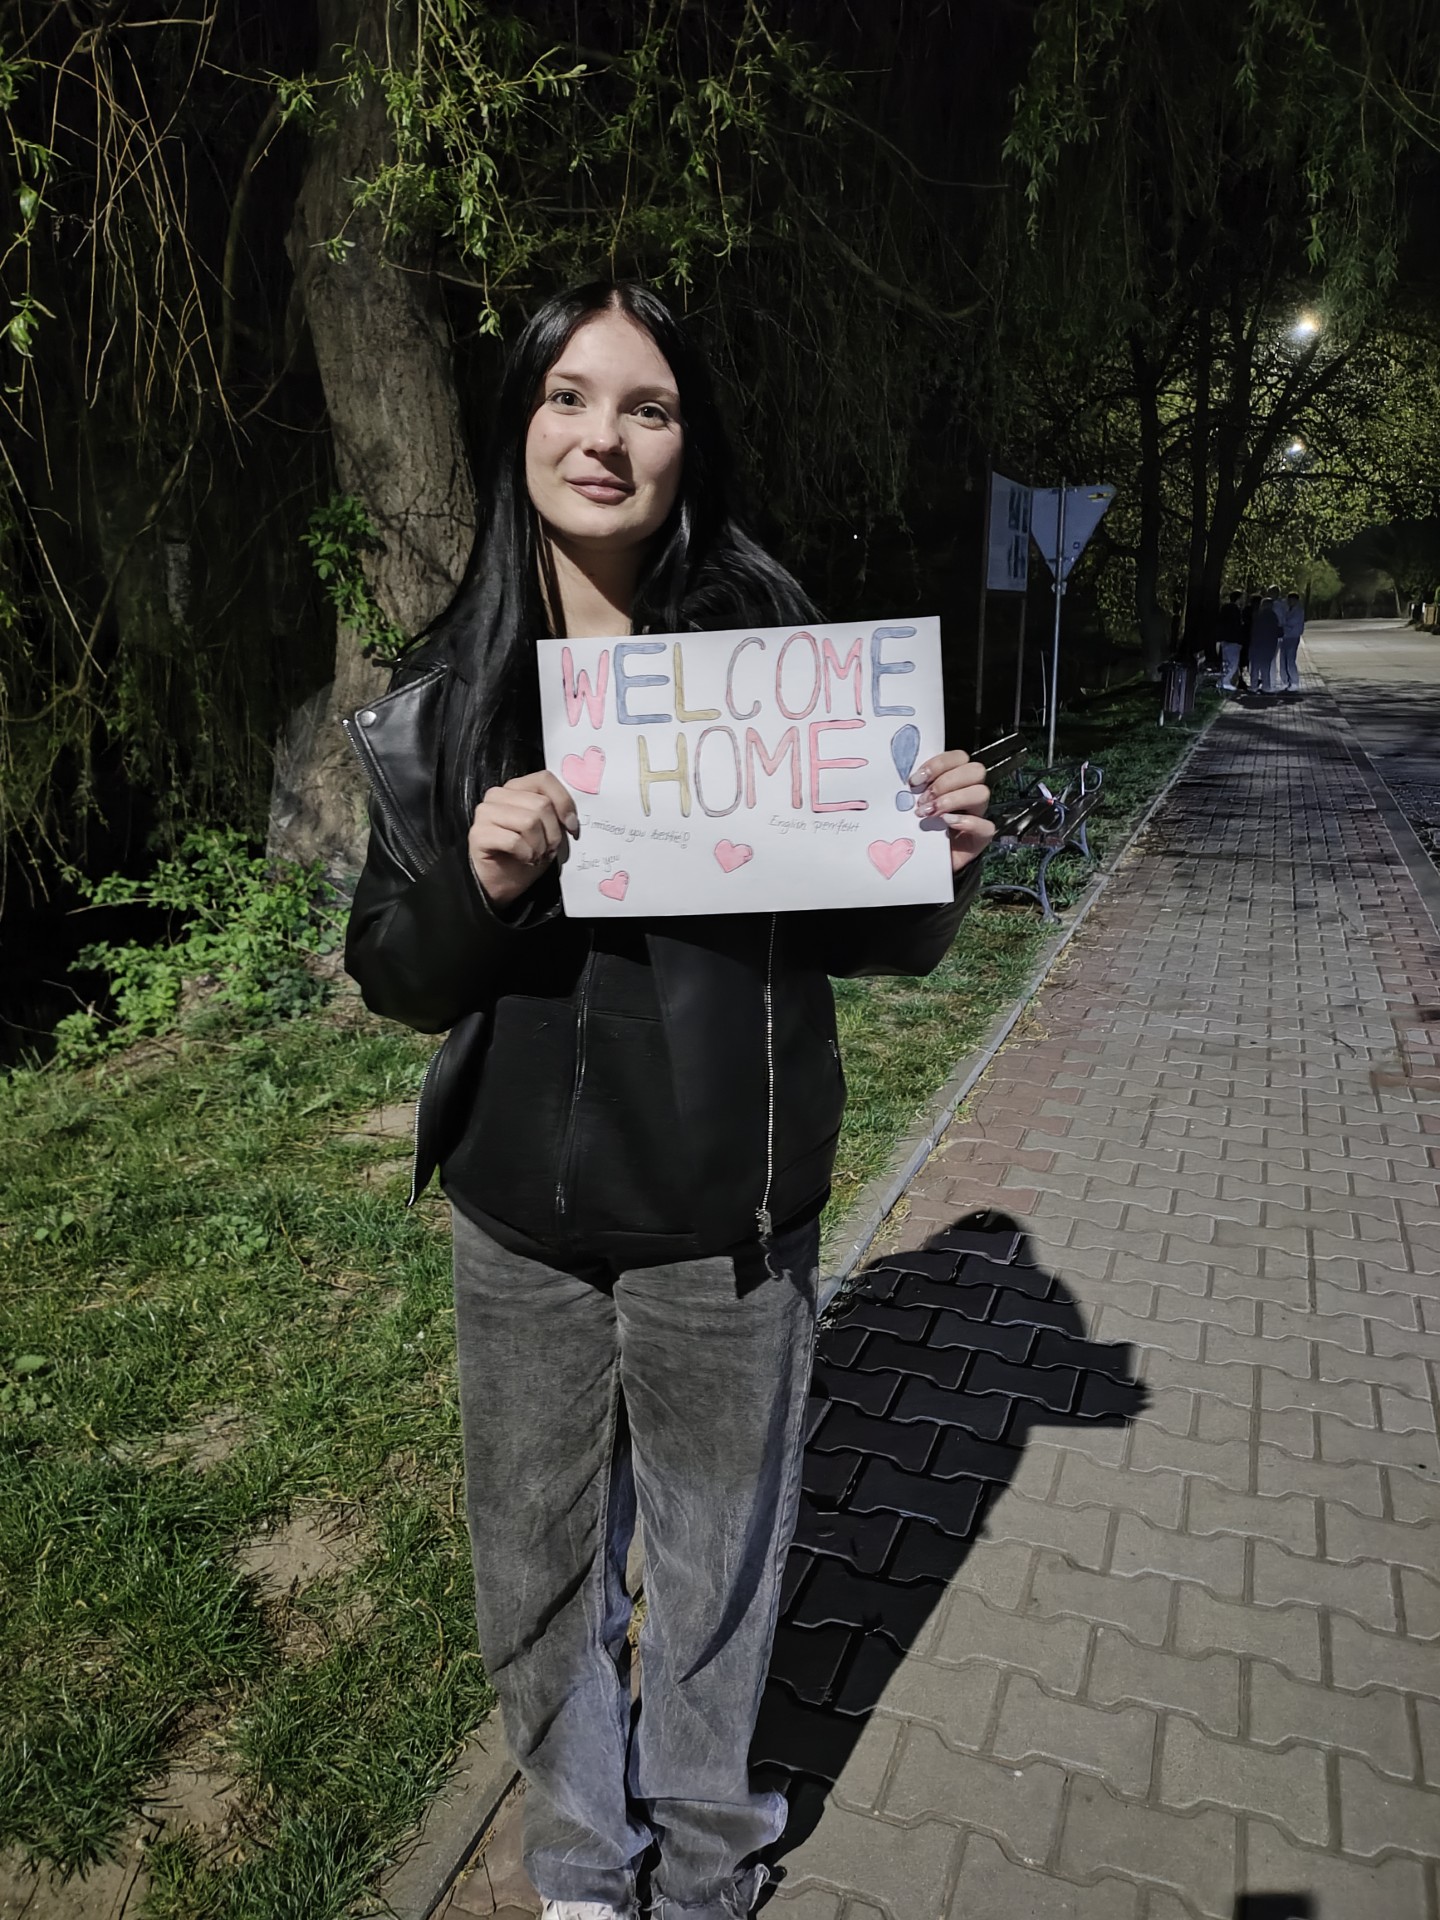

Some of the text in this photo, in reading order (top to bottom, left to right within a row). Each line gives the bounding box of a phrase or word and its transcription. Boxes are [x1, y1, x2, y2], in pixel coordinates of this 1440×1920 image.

[562, 626, 917, 730] WELCOME
[768, 814, 808, 834] English
[625, 828, 646, 842] you
[602, 855, 620, 873] you
